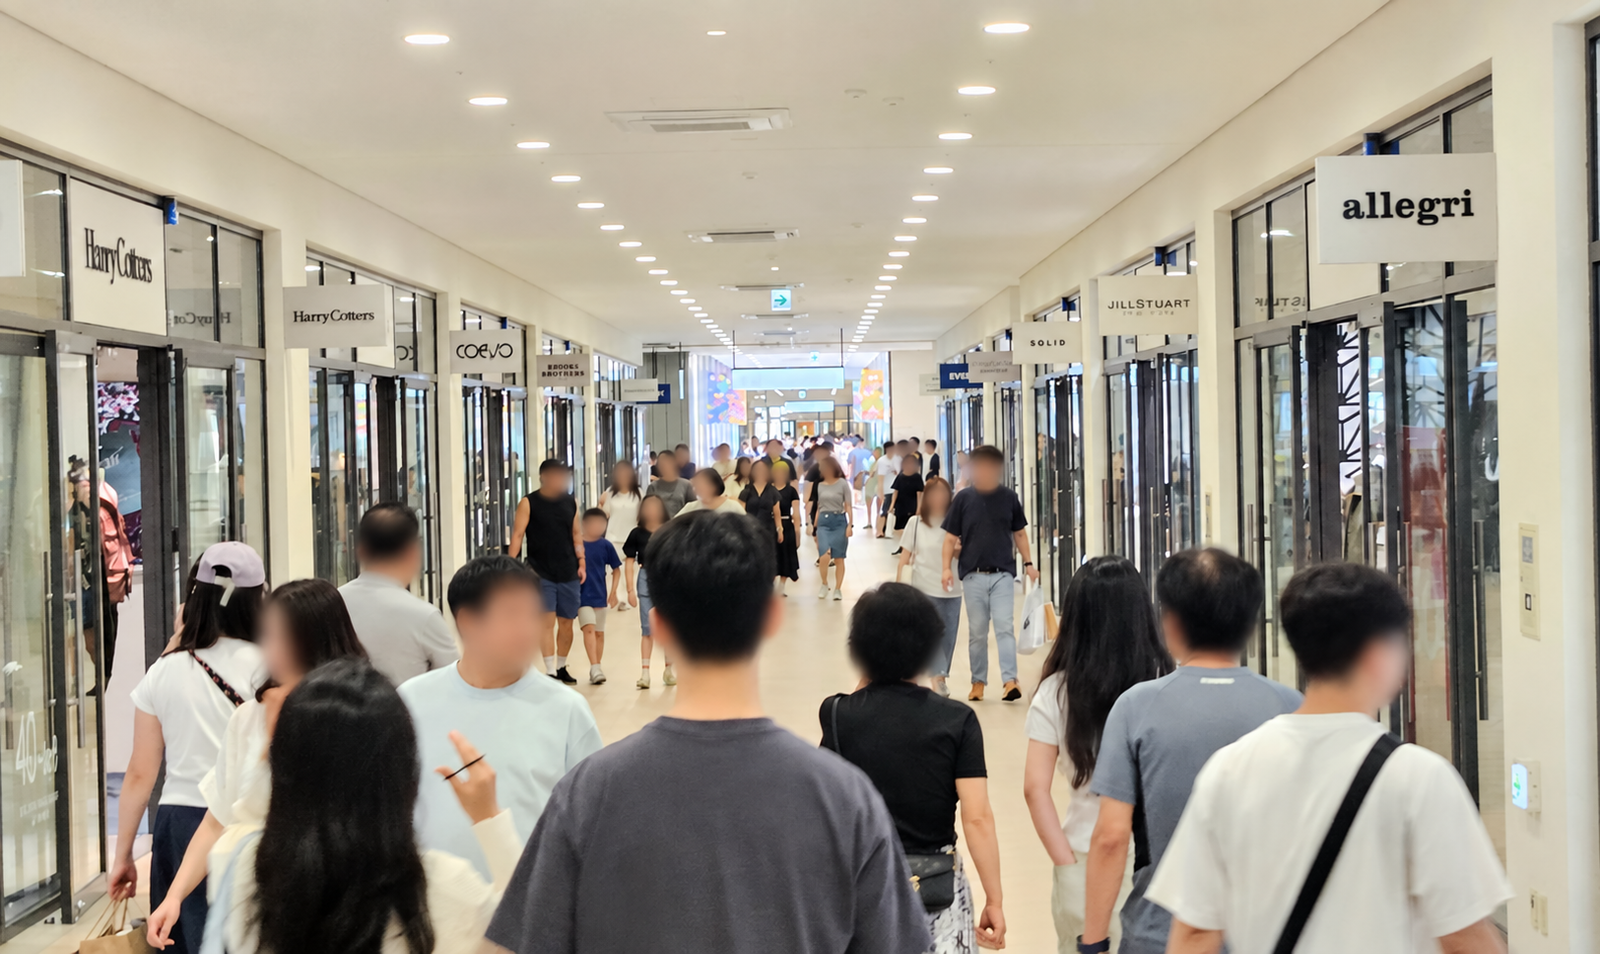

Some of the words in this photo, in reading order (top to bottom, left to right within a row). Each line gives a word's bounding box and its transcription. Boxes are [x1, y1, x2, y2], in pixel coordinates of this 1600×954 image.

[1342, 188, 1474, 226] allegri
[1029, 339, 1066, 347] SOLID
[547, 363, 579, 371] BROOKS
[541, 370, 585, 378] BROTHERS
